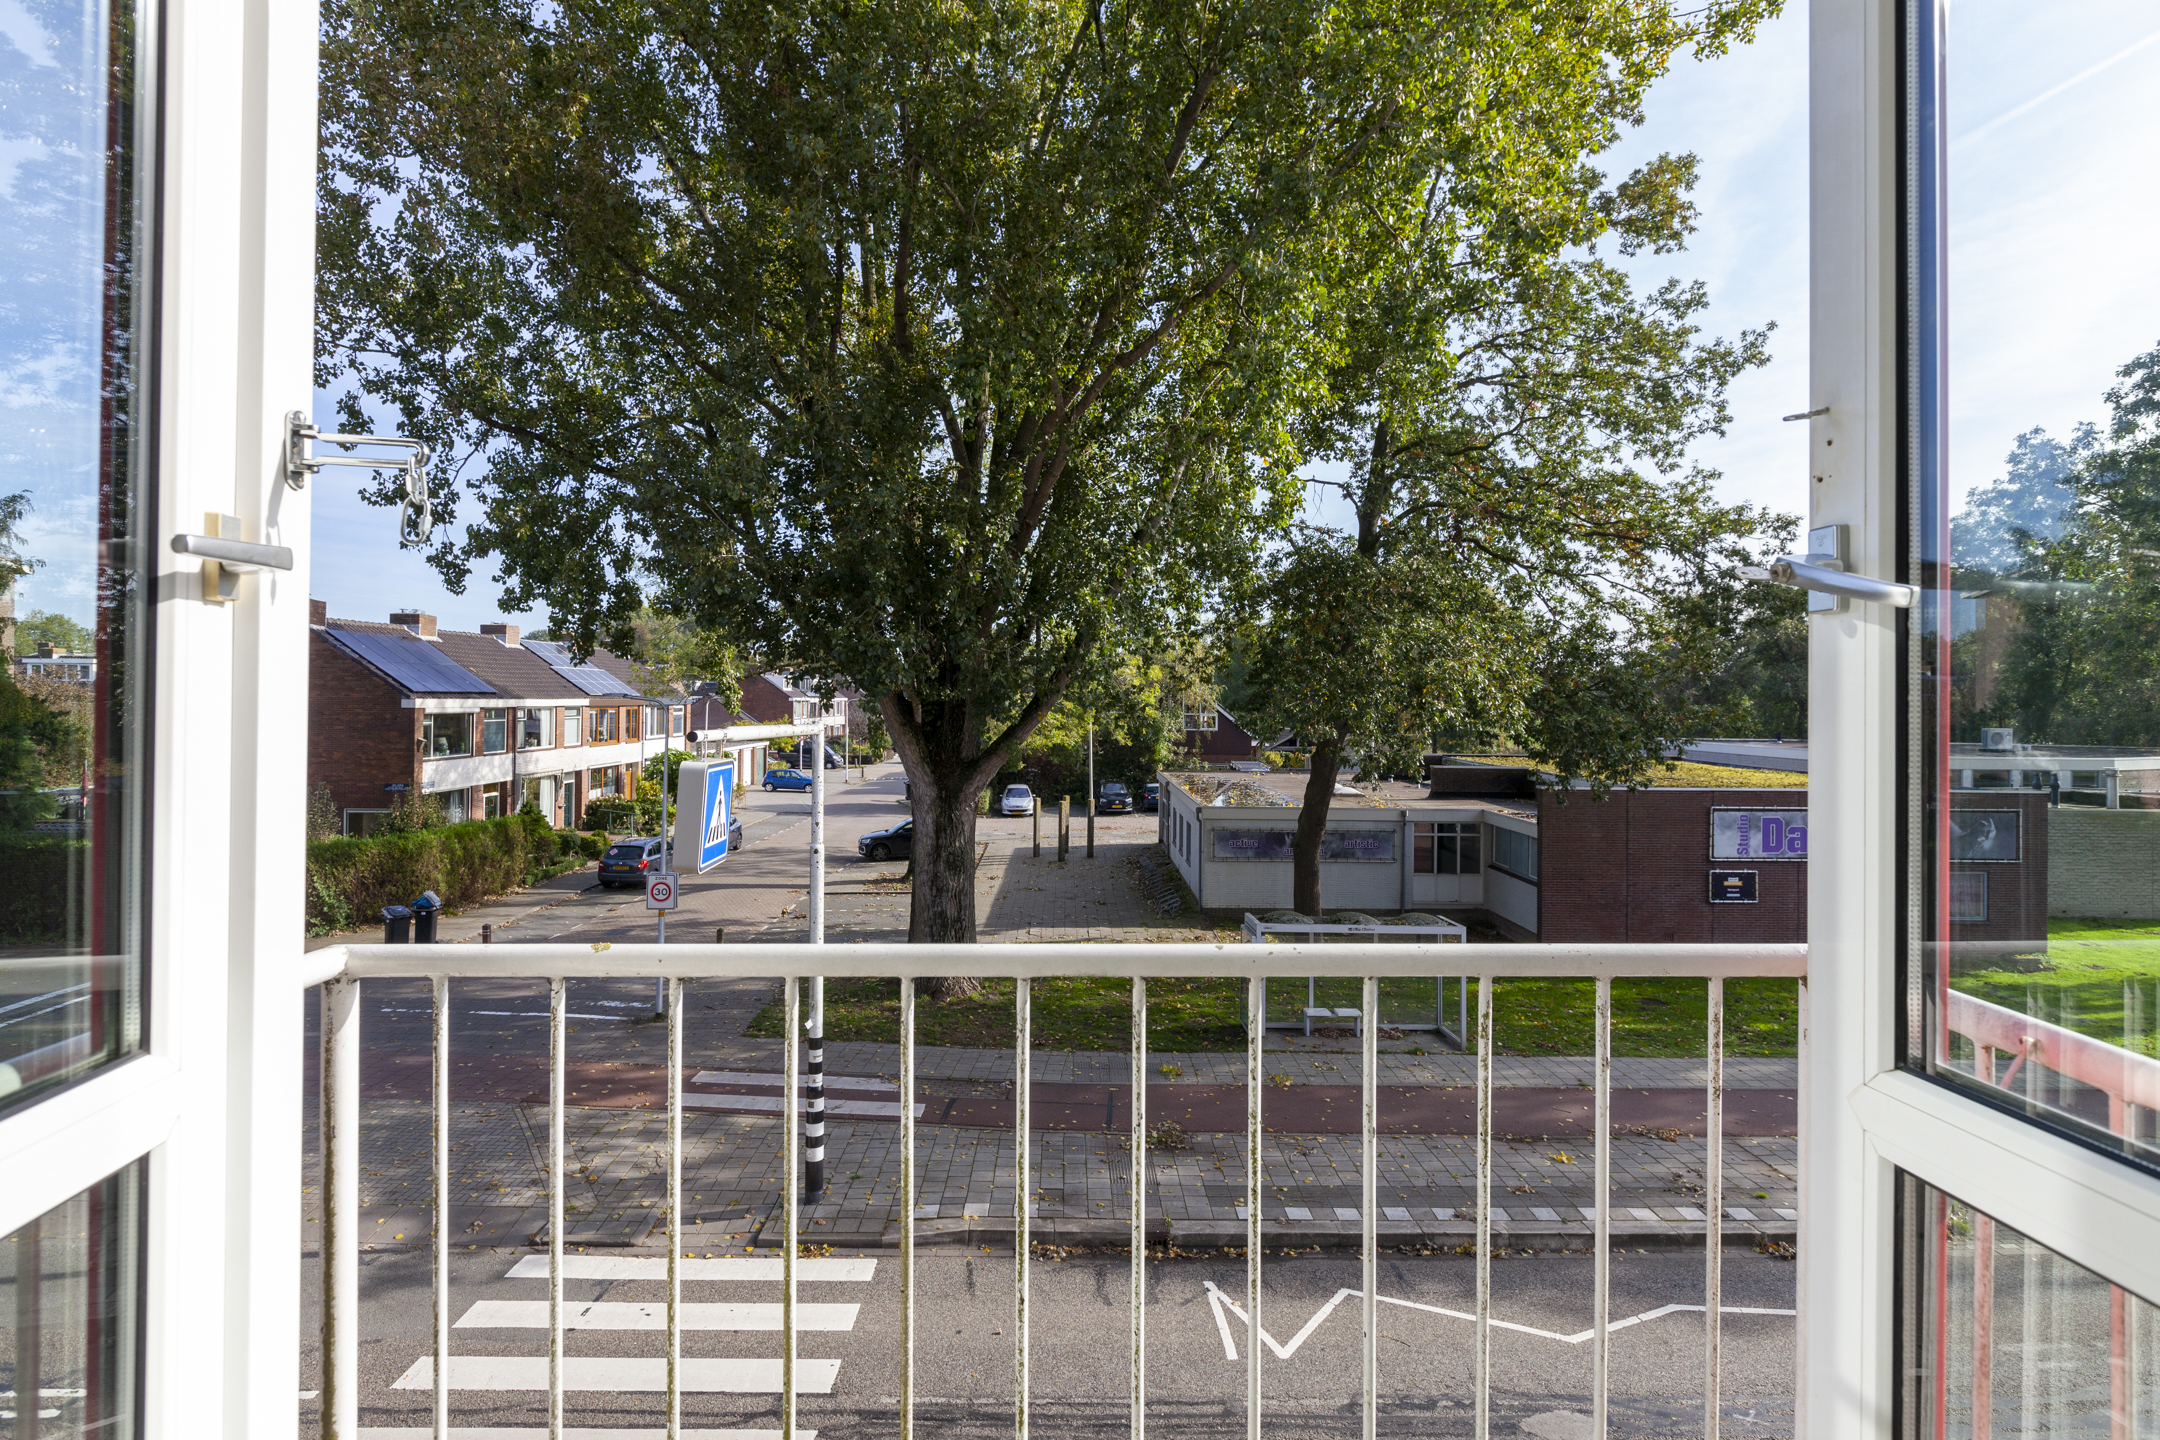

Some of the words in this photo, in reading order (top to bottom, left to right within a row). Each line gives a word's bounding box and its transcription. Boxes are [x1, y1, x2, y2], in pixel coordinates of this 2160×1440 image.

[1737, 815, 1749, 855] Studio
[1229, 838, 1258, 848] active
[1344, 839, 1379, 848] artistic
[655, 888, 668, 896] 30
